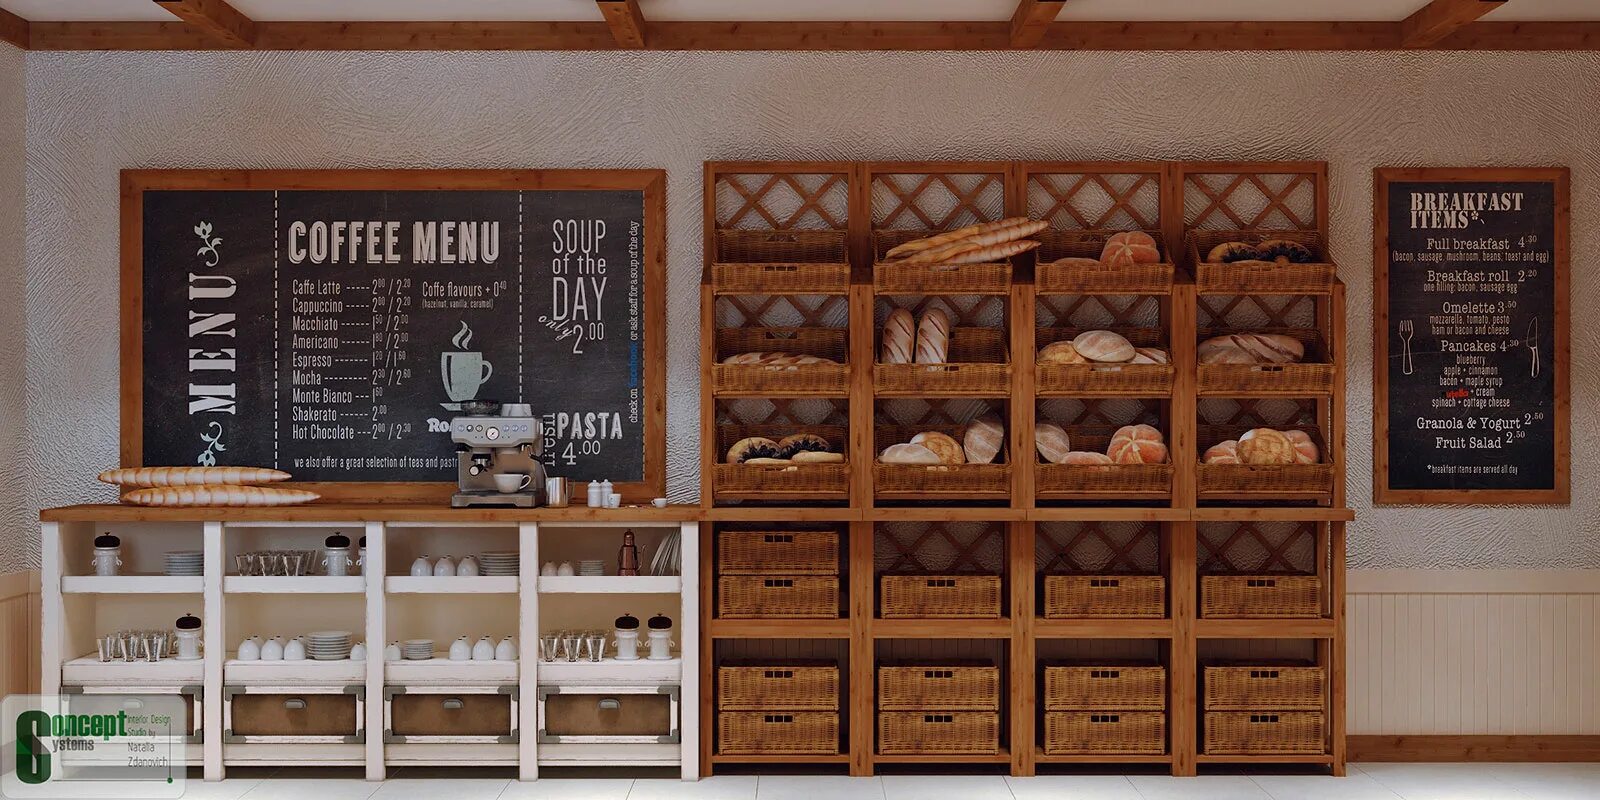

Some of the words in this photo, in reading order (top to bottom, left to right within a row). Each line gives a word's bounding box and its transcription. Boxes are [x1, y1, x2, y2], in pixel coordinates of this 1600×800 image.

[1410, 192, 1524, 211] BREAKFAST
[552, 219, 606, 254] SOUP
[629, 221, 640, 236] day
[288, 220, 401, 264] COFFEE
[412, 221, 500, 264] MENU
[629, 237, 638, 250] the
[1427, 238, 1450, 250] Full
[1453, 238, 1509, 250] breakfast
[629, 250, 638, 259] of
[552, 252, 570, 274] of
[577, 252, 606, 274] the
[630, 259, 640, 279] soup
[1427, 270, 1485, 282] Breakfast
[1488, 270, 1509, 282] roll
[292, 279, 315, 295] Caffe
[317, 279, 341, 295] Latte
[422, 281, 445, 297] Coffe
[447, 281, 482, 297] flavours
[629, 285, 638, 297] for
[292, 297, 343, 315] Cappuccino
[553, 277, 607, 320] DAY
[629, 297, 638, 316] staff
[1442, 302, 1495, 314] Omelette
[292, 315, 338, 331] Macchiato
[538, 315, 573, 341] only
[629, 316, 638, 332] ask
[1492, 315, 1510, 326] pesto
[573, 322, 604, 354] 2.00
[630, 332, 638, 341] or
[1475, 325, 1486, 335] and
[1487, 325, 1509, 335] cheese
[188, 272, 237, 415] MENU
[292, 333, 339, 349] Americano
[1441, 340, 1496, 352] Pancakes
[292, 352, 332, 369] Espresso
[1456, 354, 1486, 366] blueberry
[292, 370, 322, 386] Mocha
[1444, 365, 1461, 376] apple
[1468, 365, 1498, 375] cinnamon
[1440, 377, 1458, 386] bacon
[1465, 377, 1484, 387] maple
[1485, 377, 1503, 387] syrup
[292, 388, 320, 403] Monte
[323, 388, 353, 403] Bianco
[630, 388, 638, 399] on
[1476, 388, 1495, 397] cream
[629, 399, 638, 423] check
[1432, 397, 1456, 409] spinach
[1463, 397, 1487, 409] cottage
[1488, 397, 1510, 408] cheese
[292, 406, 337, 422] Shakerato
[1416, 417, 1464, 429] Granola
[1466, 417, 1477, 429] &
[1480, 417, 1521, 431] Yogurt
[1524, 413, 1544, 425] 2.50
[292, 424, 308, 440] Hot
[310, 424, 355, 440] Chocolate
[557, 412, 623, 440] PASTA
[1435, 437, 1466, 449] Fruit
[1469, 437, 1502, 449] Salad
[562, 440, 601, 465] 4.00
[294, 459, 305, 468] we
[305, 456, 321, 468] also
[321, 456, 338, 468] offer
[340, 459, 345, 468] a
[345, 457, 364, 470] great
[365, 456, 398, 468] selection
[399, 456, 407, 468] of
[408, 457, 424, 468] teas
[425, 456, 438, 468] and
